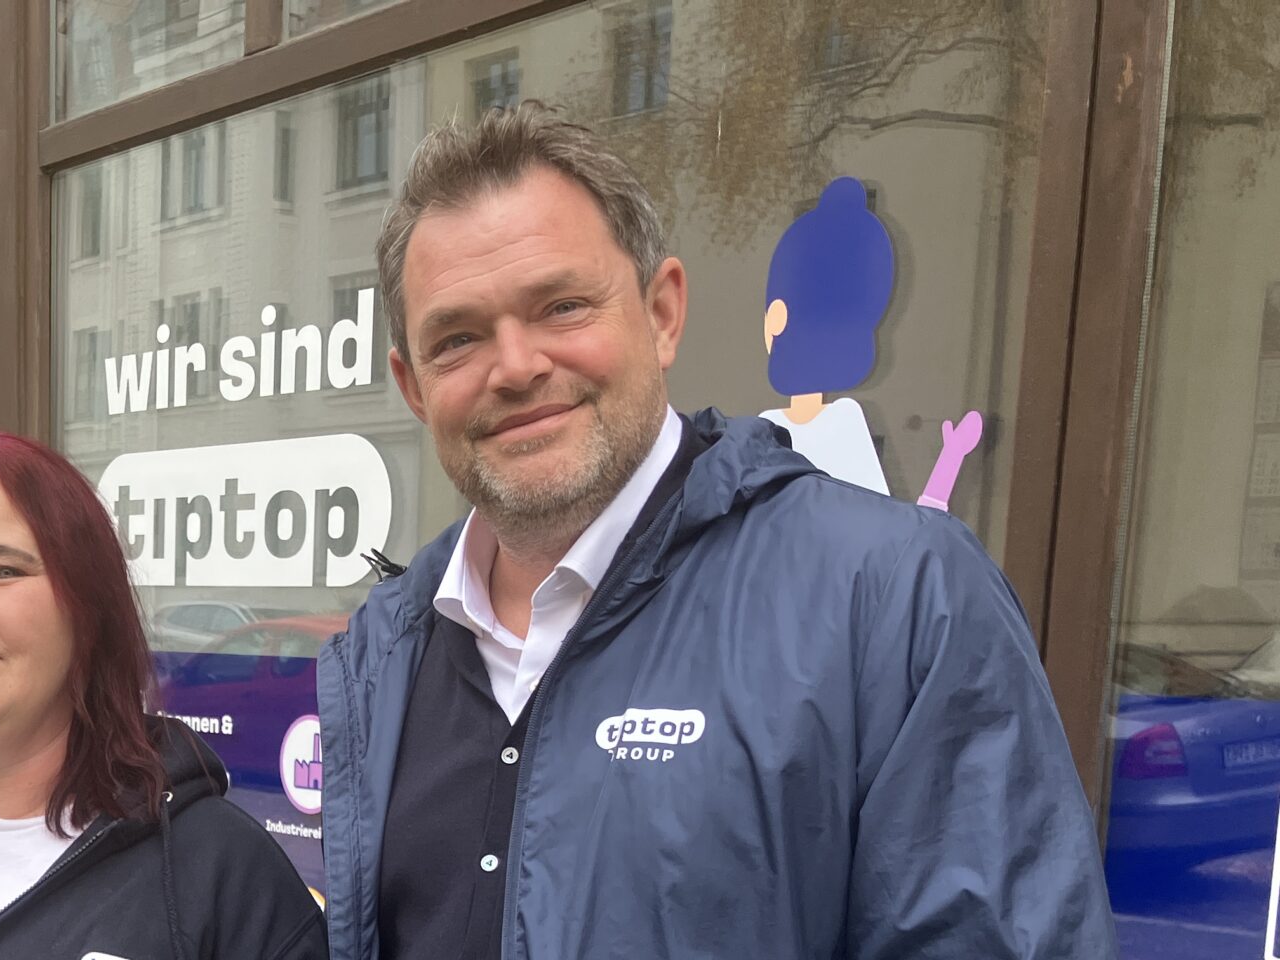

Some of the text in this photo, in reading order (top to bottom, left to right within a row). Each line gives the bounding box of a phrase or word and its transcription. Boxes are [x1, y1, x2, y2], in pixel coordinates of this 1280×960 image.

[104, 287, 375, 416] wir sind
[114, 478, 360, 587] tiptop
[221, 714, 233, 735] &
[606, 717, 695, 744] tptop
[608, 747, 675, 762] ROUP
[265, 819, 322, 839] Industrierei
